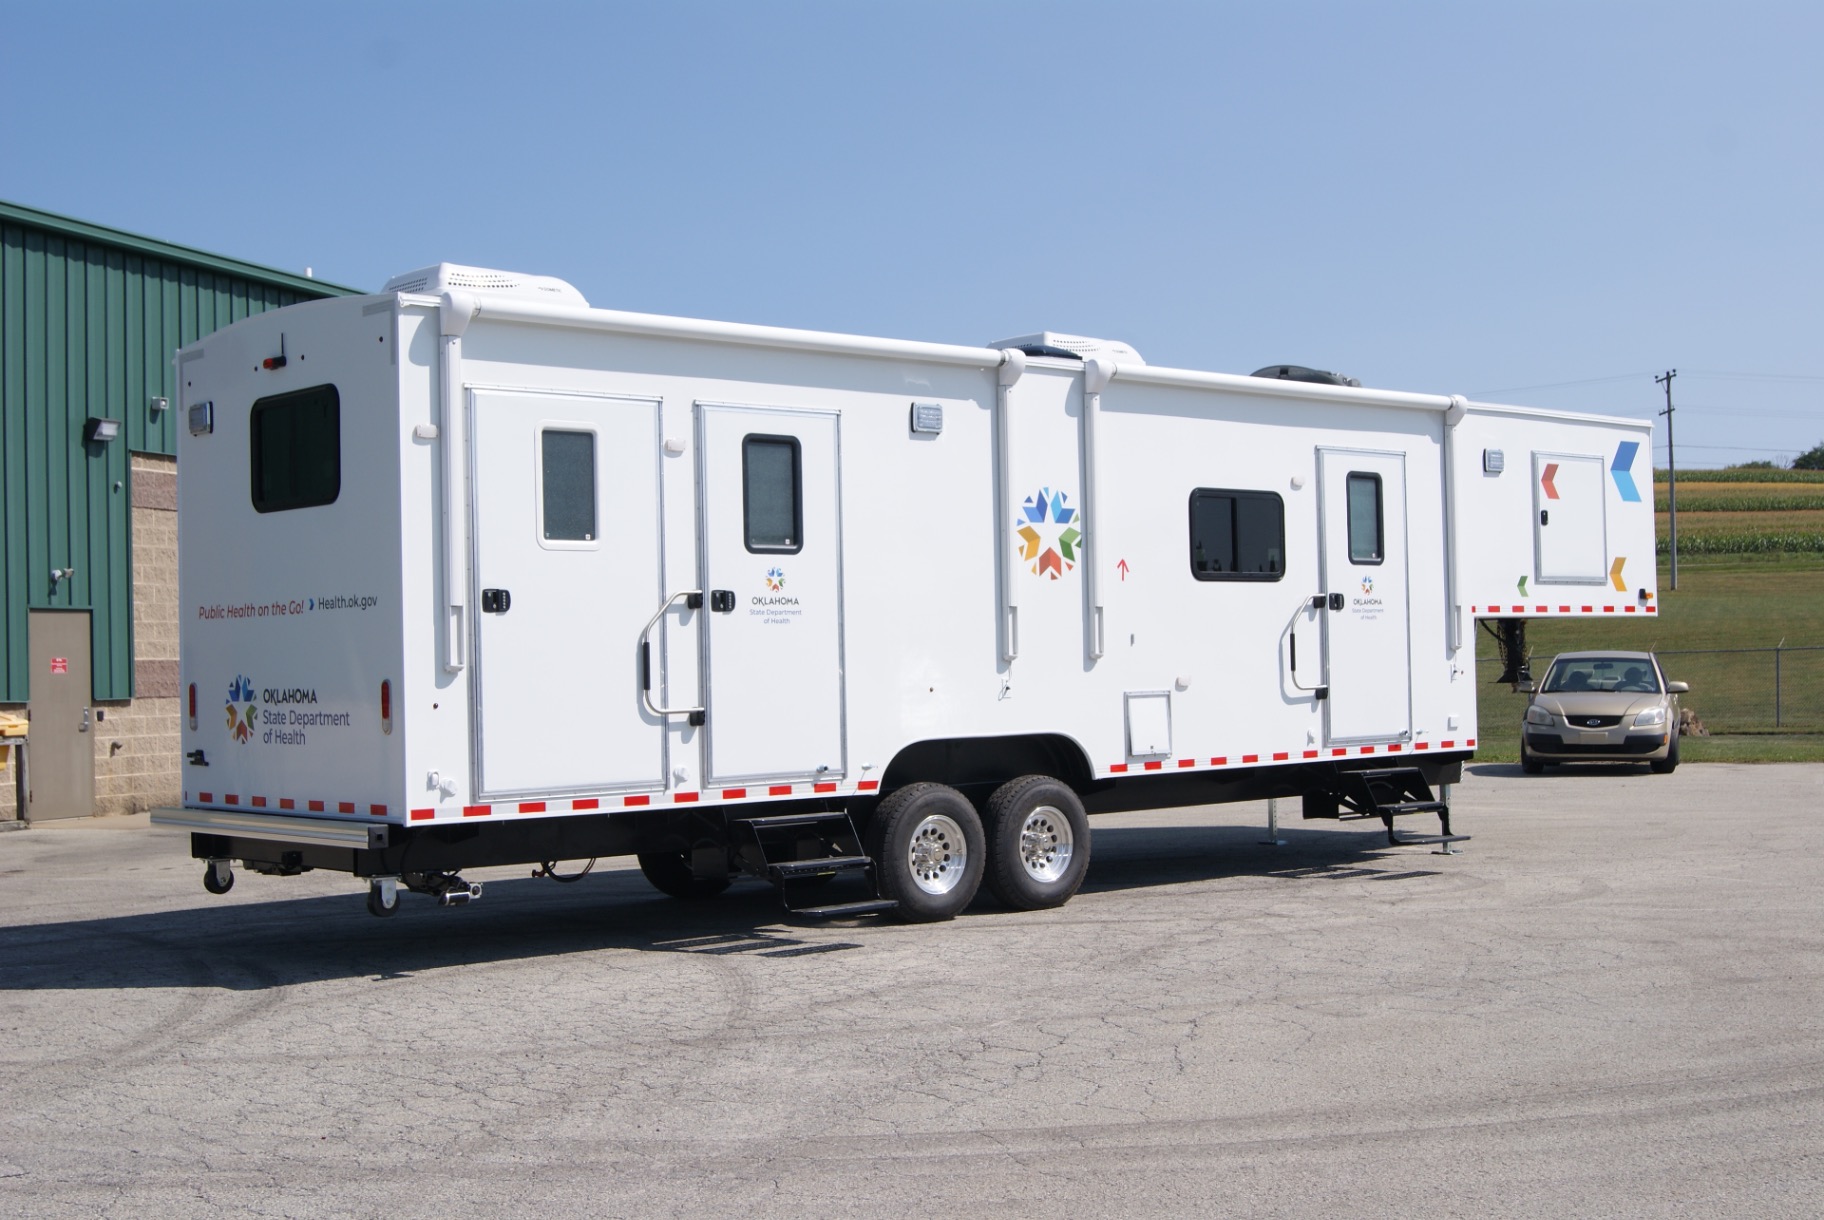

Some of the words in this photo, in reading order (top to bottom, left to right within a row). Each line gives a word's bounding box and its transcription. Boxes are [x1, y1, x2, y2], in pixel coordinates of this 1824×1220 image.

[199, 605, 225, 619] Public
[227, 603, 256, 618] Health
[258, 604, 269, 616] on
[272, 601, 287, 615] the
[289, 600, 304, 614] Go!
[318, 594, 378, 610] Health.ok.gov
[751, 596, 799, 606] OKLAHOMA
[1353, 598, 1382, 606] OKLAHOMA
[263, 688, 318, 706] OKLAHOMA
[263, 709, 286, 725] State
[289, 710, 350, 729] Department
[263, 728, 273, 744] of
[275, 729, 306, 745] Health
